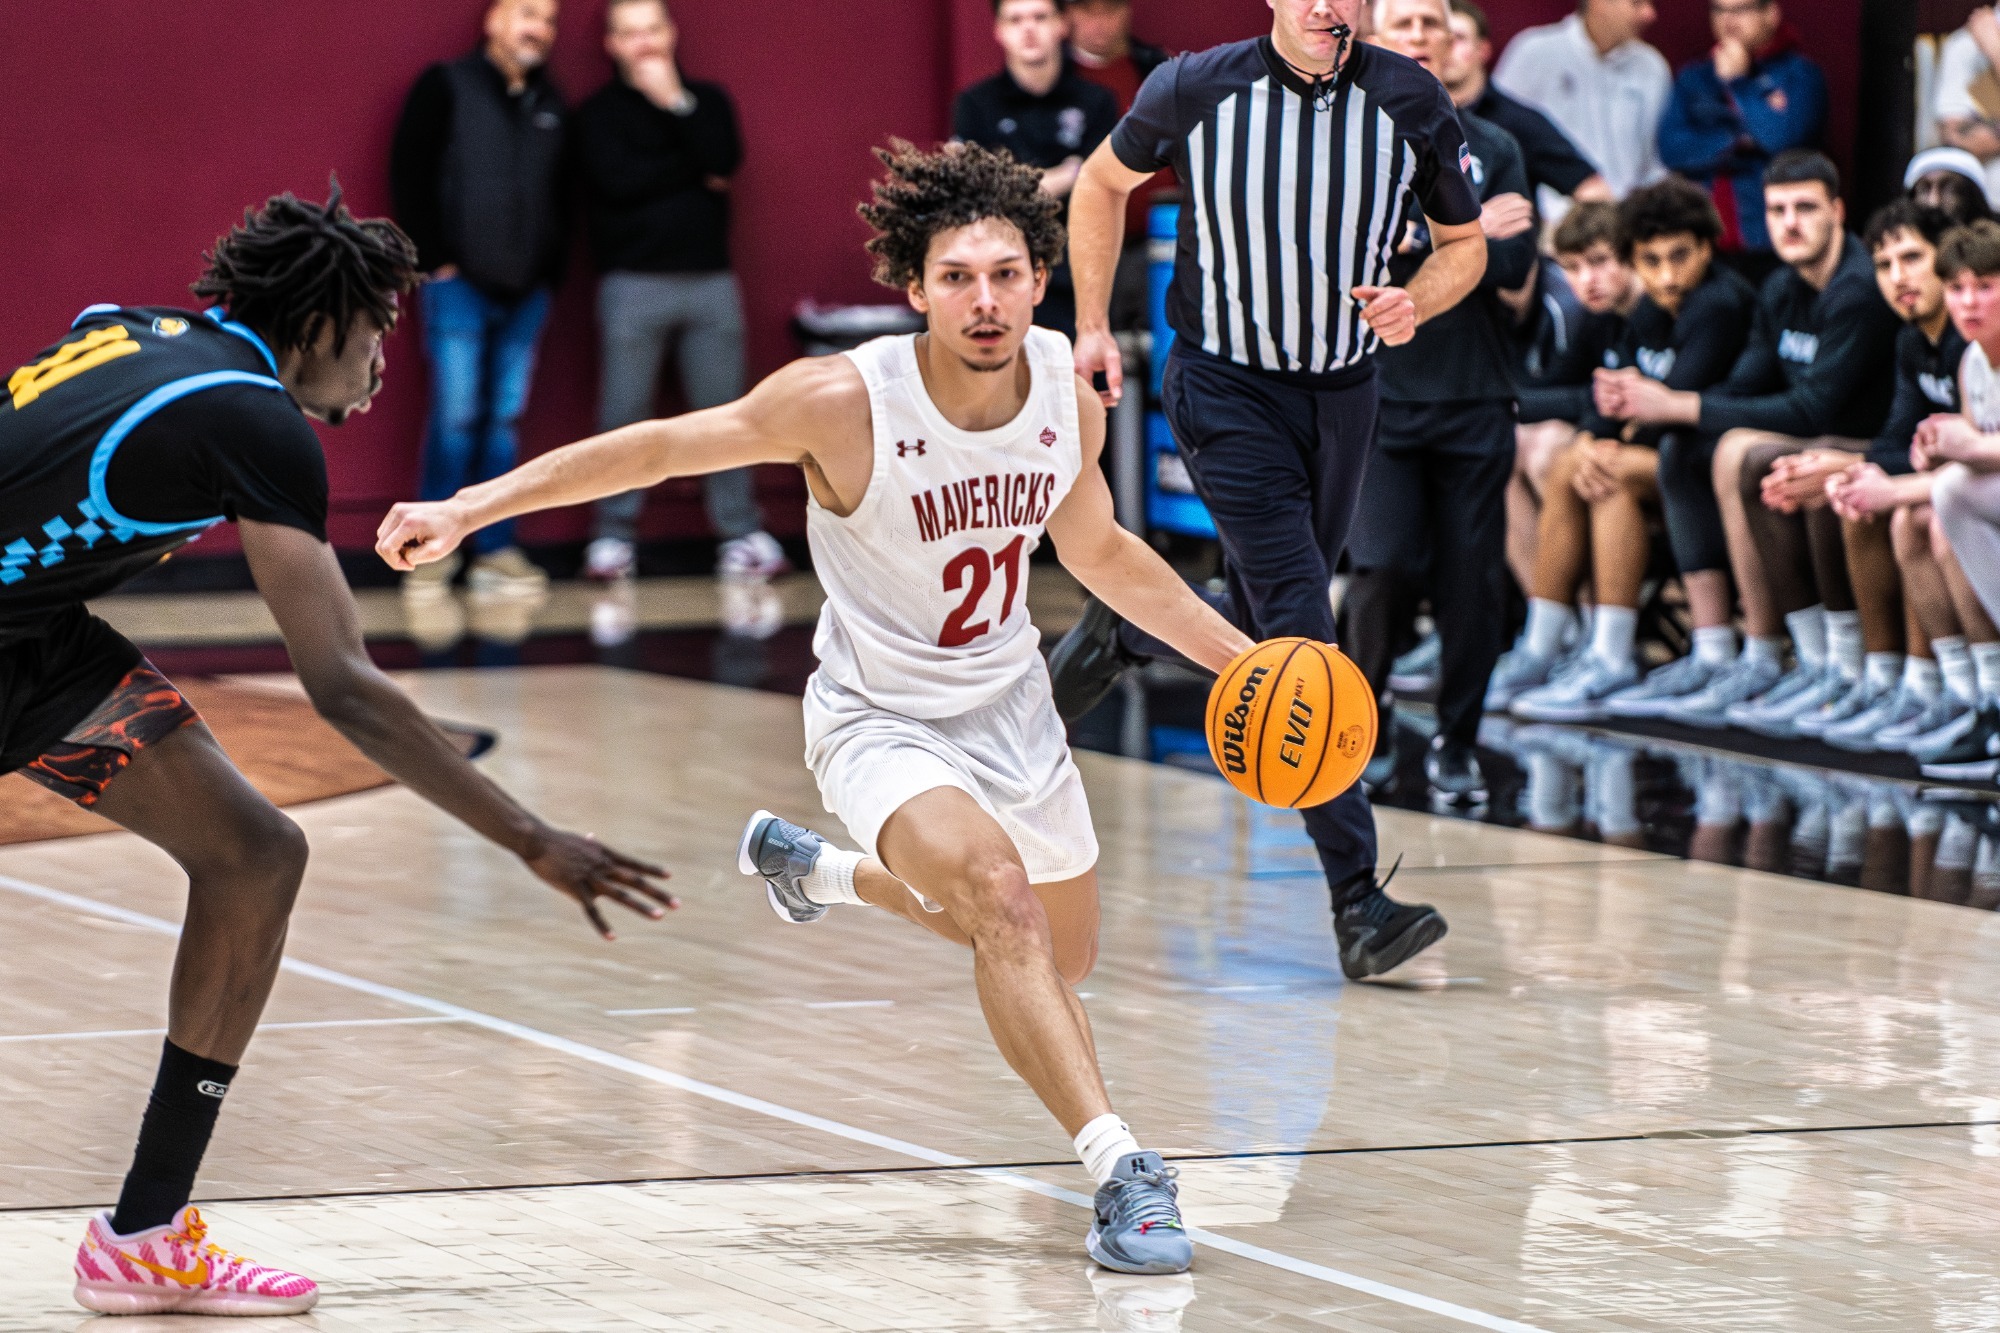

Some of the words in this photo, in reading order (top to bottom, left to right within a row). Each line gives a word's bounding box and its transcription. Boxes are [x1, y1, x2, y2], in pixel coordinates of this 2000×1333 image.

[911, 472, 1055, 542] MAVERICKS
[937, 534, 1026, 647] 21
[1222, 665, 1271, 775] Wilson
[1294, 677, 1306, 699] NXT
[1279, 697, 1314, 769] EVO
